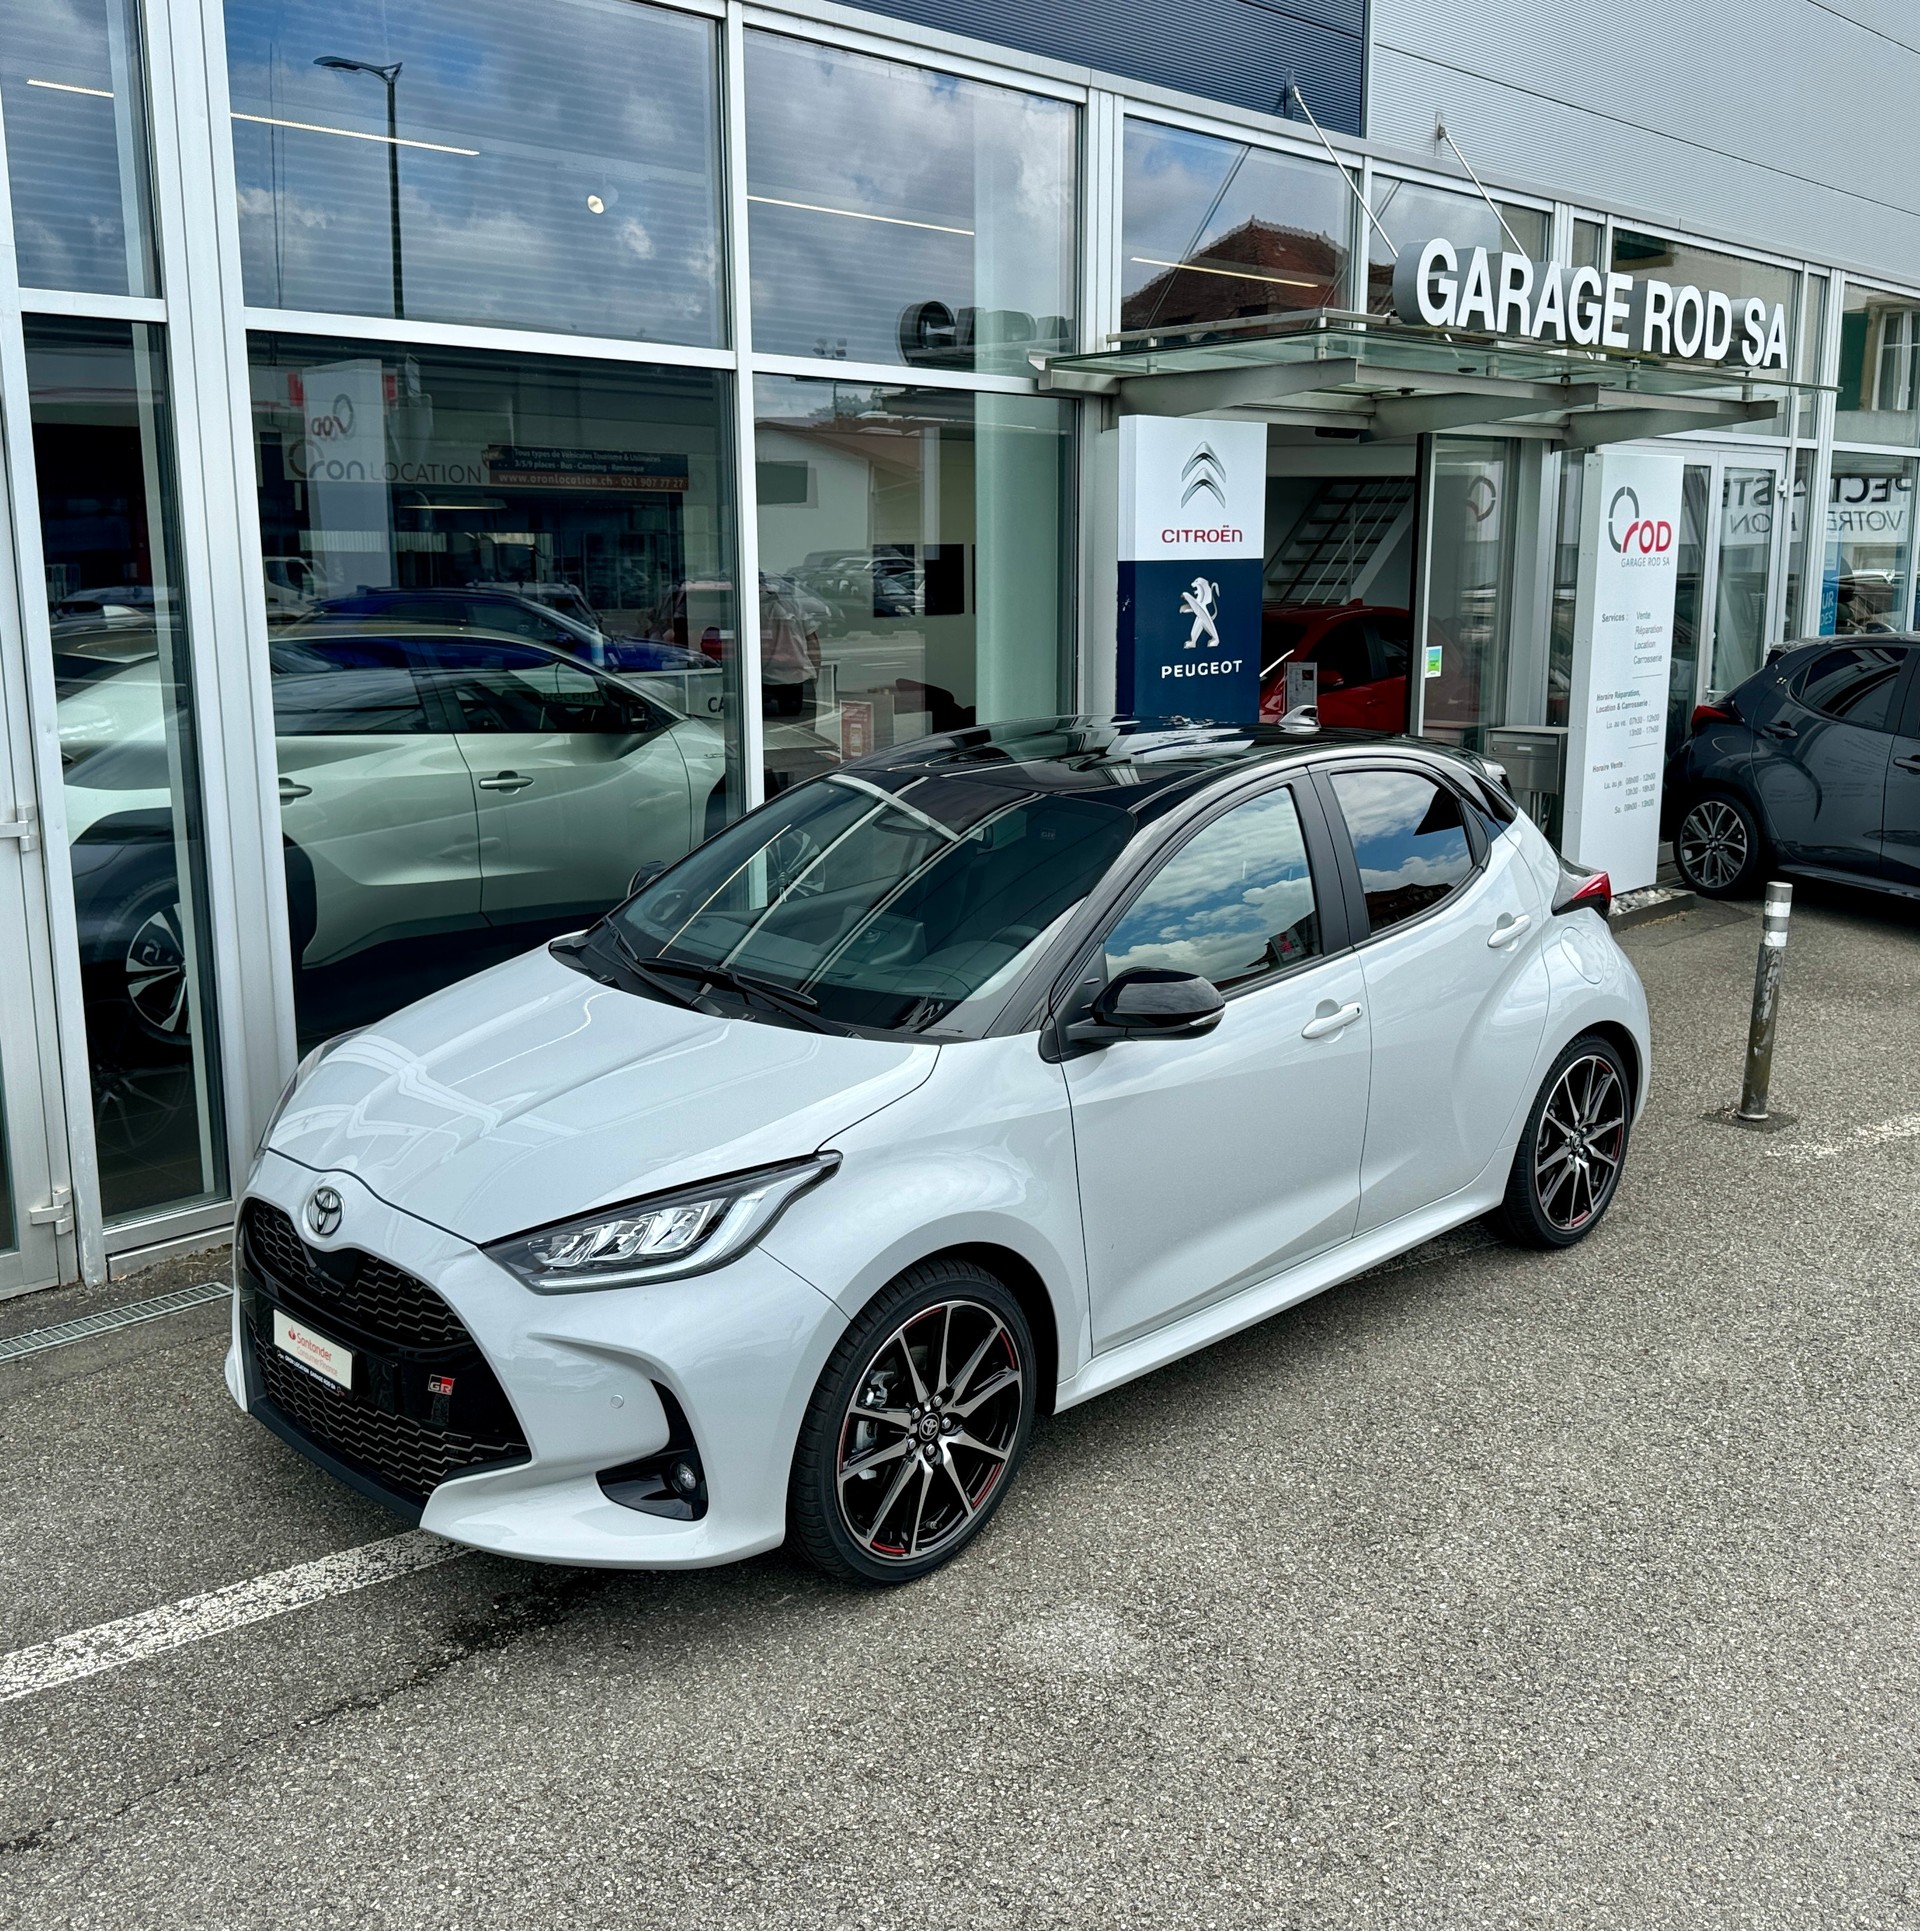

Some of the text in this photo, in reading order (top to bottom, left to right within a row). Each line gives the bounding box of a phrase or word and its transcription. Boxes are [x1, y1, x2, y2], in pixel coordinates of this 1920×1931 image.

[1416, 238, 1788, 369] GARAGE ROD SA
[370, 462, 482, 484] LOCATION
[498, 472, 613, 486] www.oronlocation.ch
[621, 478, 637, 486] 021
[641, 479, 657, 487] 907
[672, 480, 684, 488] 27
[1161, 525, 1243, 543] CITROËN
[1621, 557, 1670, 568] GARAGE ROD SA
[1602, 612, 1625, 622] Services
[1636, 611, 1651, 620] Vente
[1635, 625, 1663, 636] Réparation
[1634, 641, 1656, 650] Location
[1633, 655, 1662, 664] Carrosserie
[1161, 660, 1243, 679] PEUGEOT
[1596, 692, 1614, 701] Horaire
[1595, 703, 1616, 713] Location
[296, 1332, 332, 1361] Santander
[430, 1381, 451, 1394] GR
